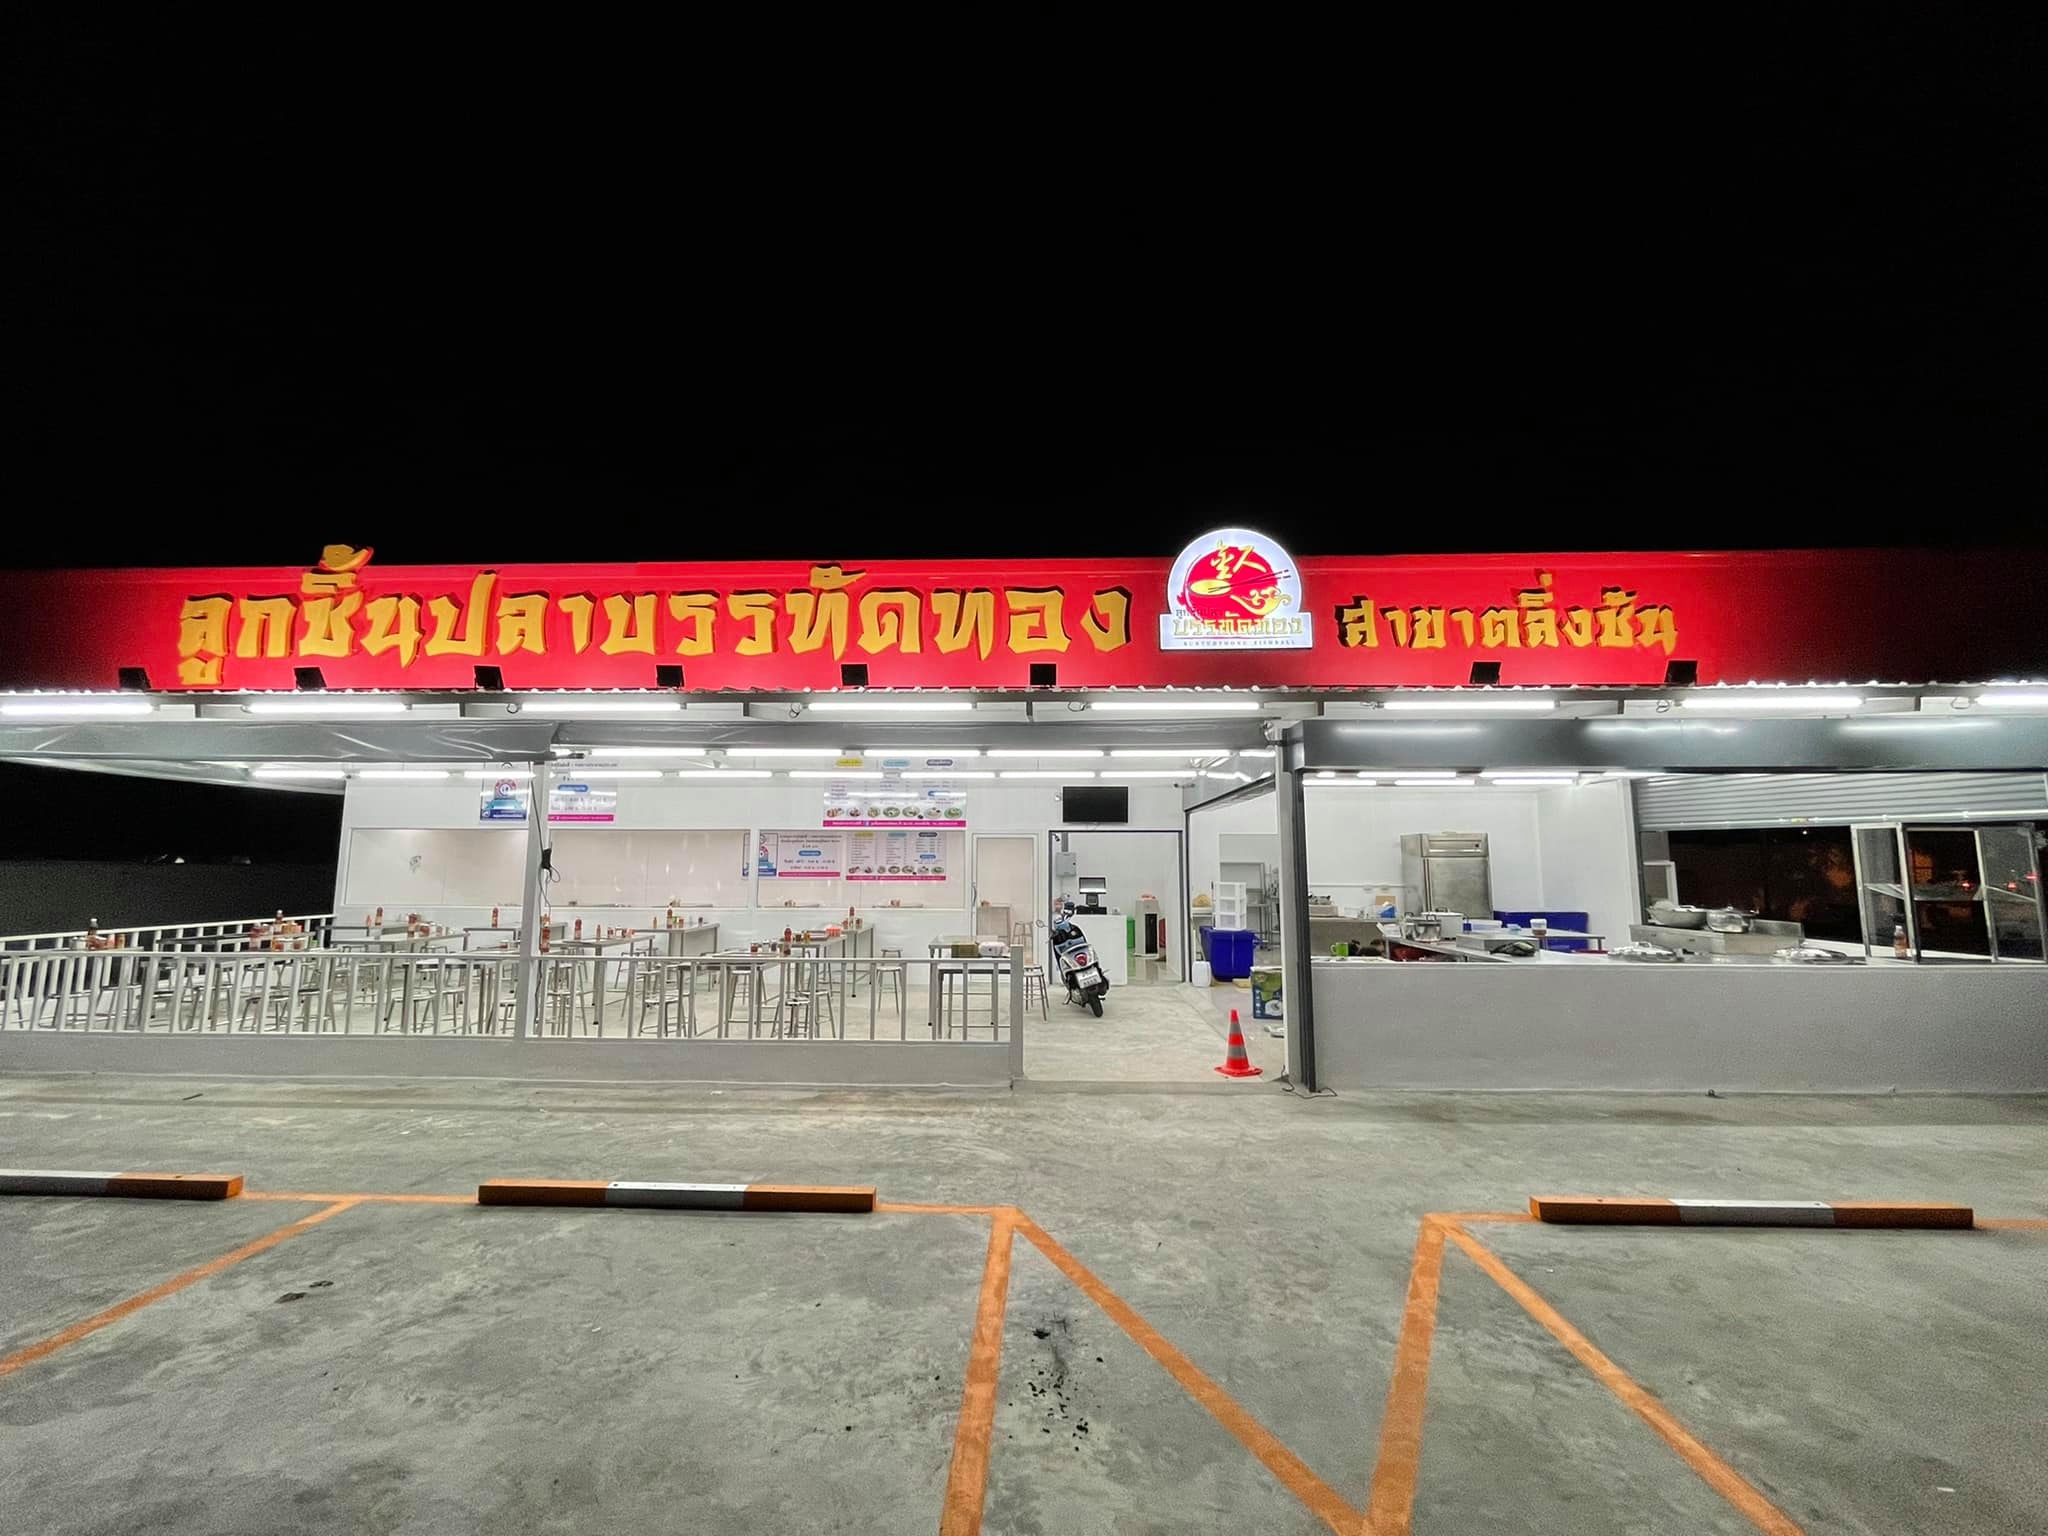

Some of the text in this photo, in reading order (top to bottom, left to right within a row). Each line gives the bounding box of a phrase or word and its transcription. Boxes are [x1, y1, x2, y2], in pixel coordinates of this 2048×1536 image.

[1338, 571, 1678, 656] สาขาตลิ่งชัน
